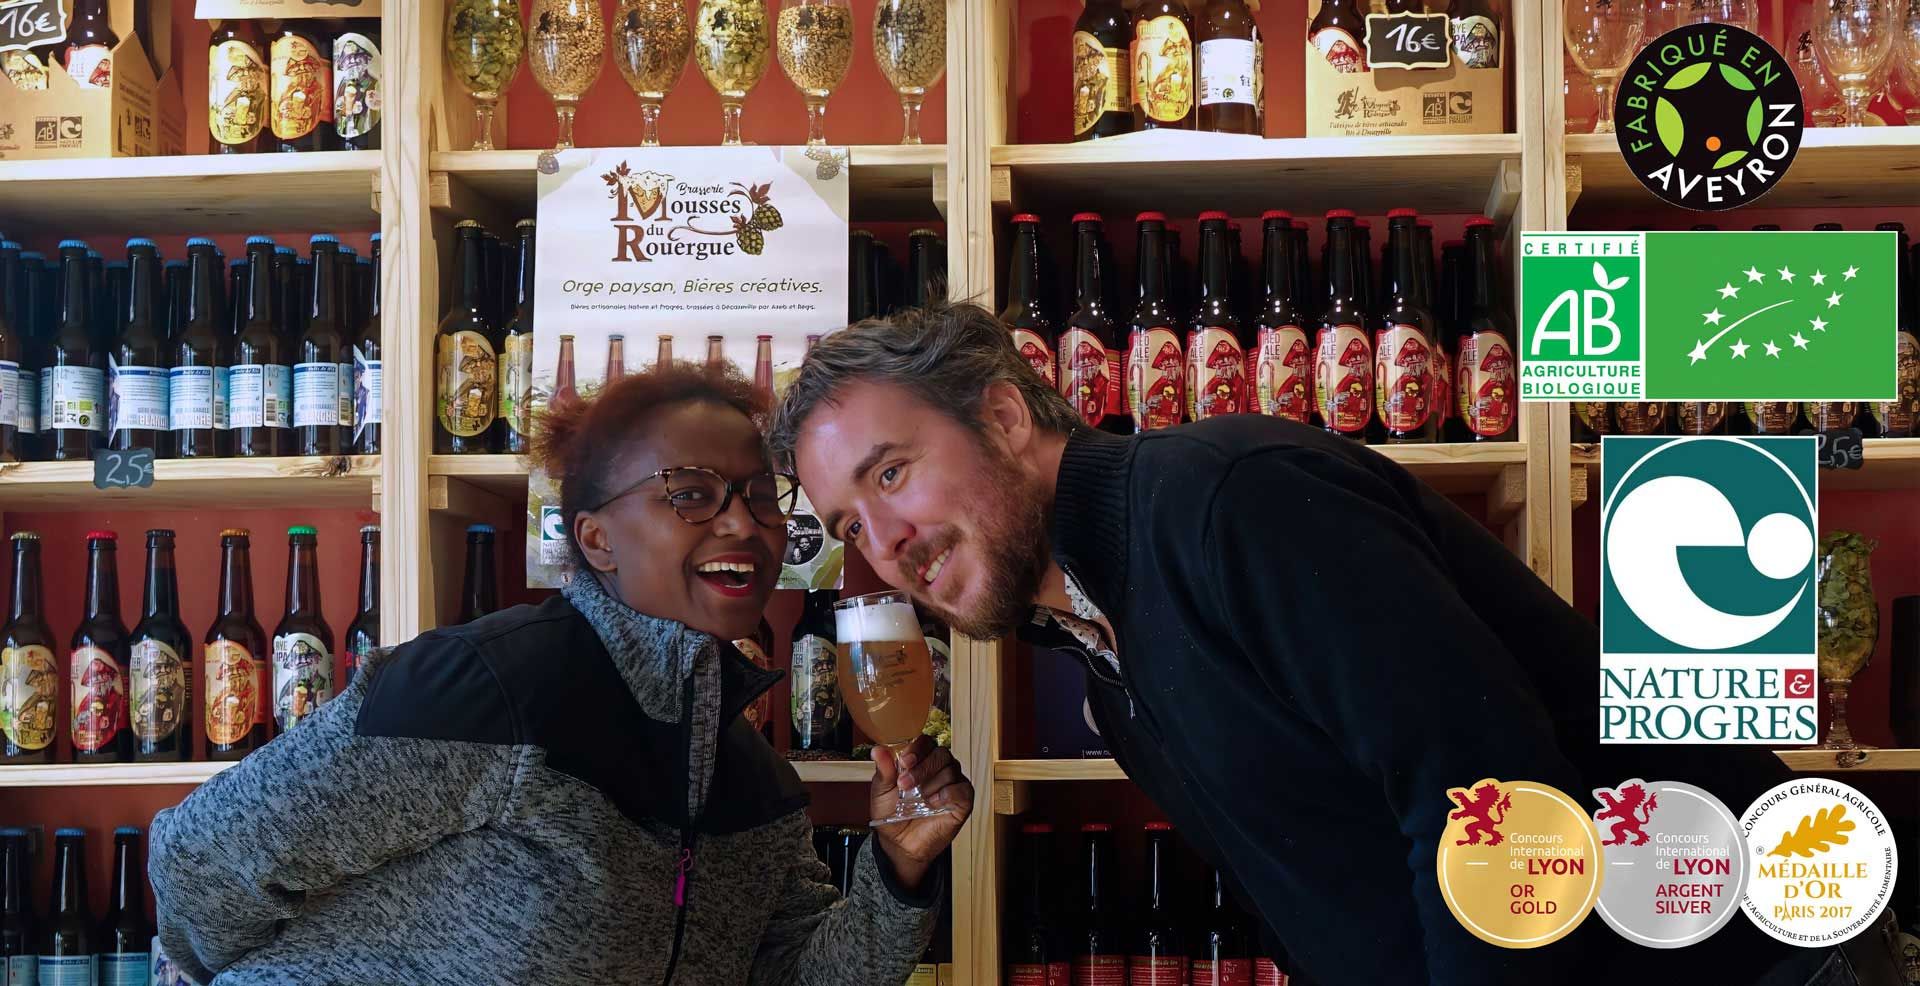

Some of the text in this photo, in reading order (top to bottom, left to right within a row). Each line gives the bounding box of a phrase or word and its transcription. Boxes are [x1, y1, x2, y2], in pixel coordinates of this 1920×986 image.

[0, 5, 57, 39] 16€
[1385, 23, 1441, 52] 16€
[1424, 102, 1444, 116] AB
[676, 182, 724, 196] Brasserie
[610, 171, 741, 222] Mousses
[646, 224, 665, 236] du
[612, 224, 735, 262] Rouergue
[562, 277, 824, 296] Orge paysan, Bières créatives.
[1134, 335, 1150, 345] RED
[1263, 333, 1281, 344] RED
[1321, 333, 1337, 344] RED
[1134, 346, 1150, 358] ALE
[1264, 344, 1281, 356] ALE
[1321, 344, 1337, 356] ALE
[105, 454, 153, 486] 2,5€
[276, 640, 288, 650] RYE
[276, 651, 288, 662] IPA
